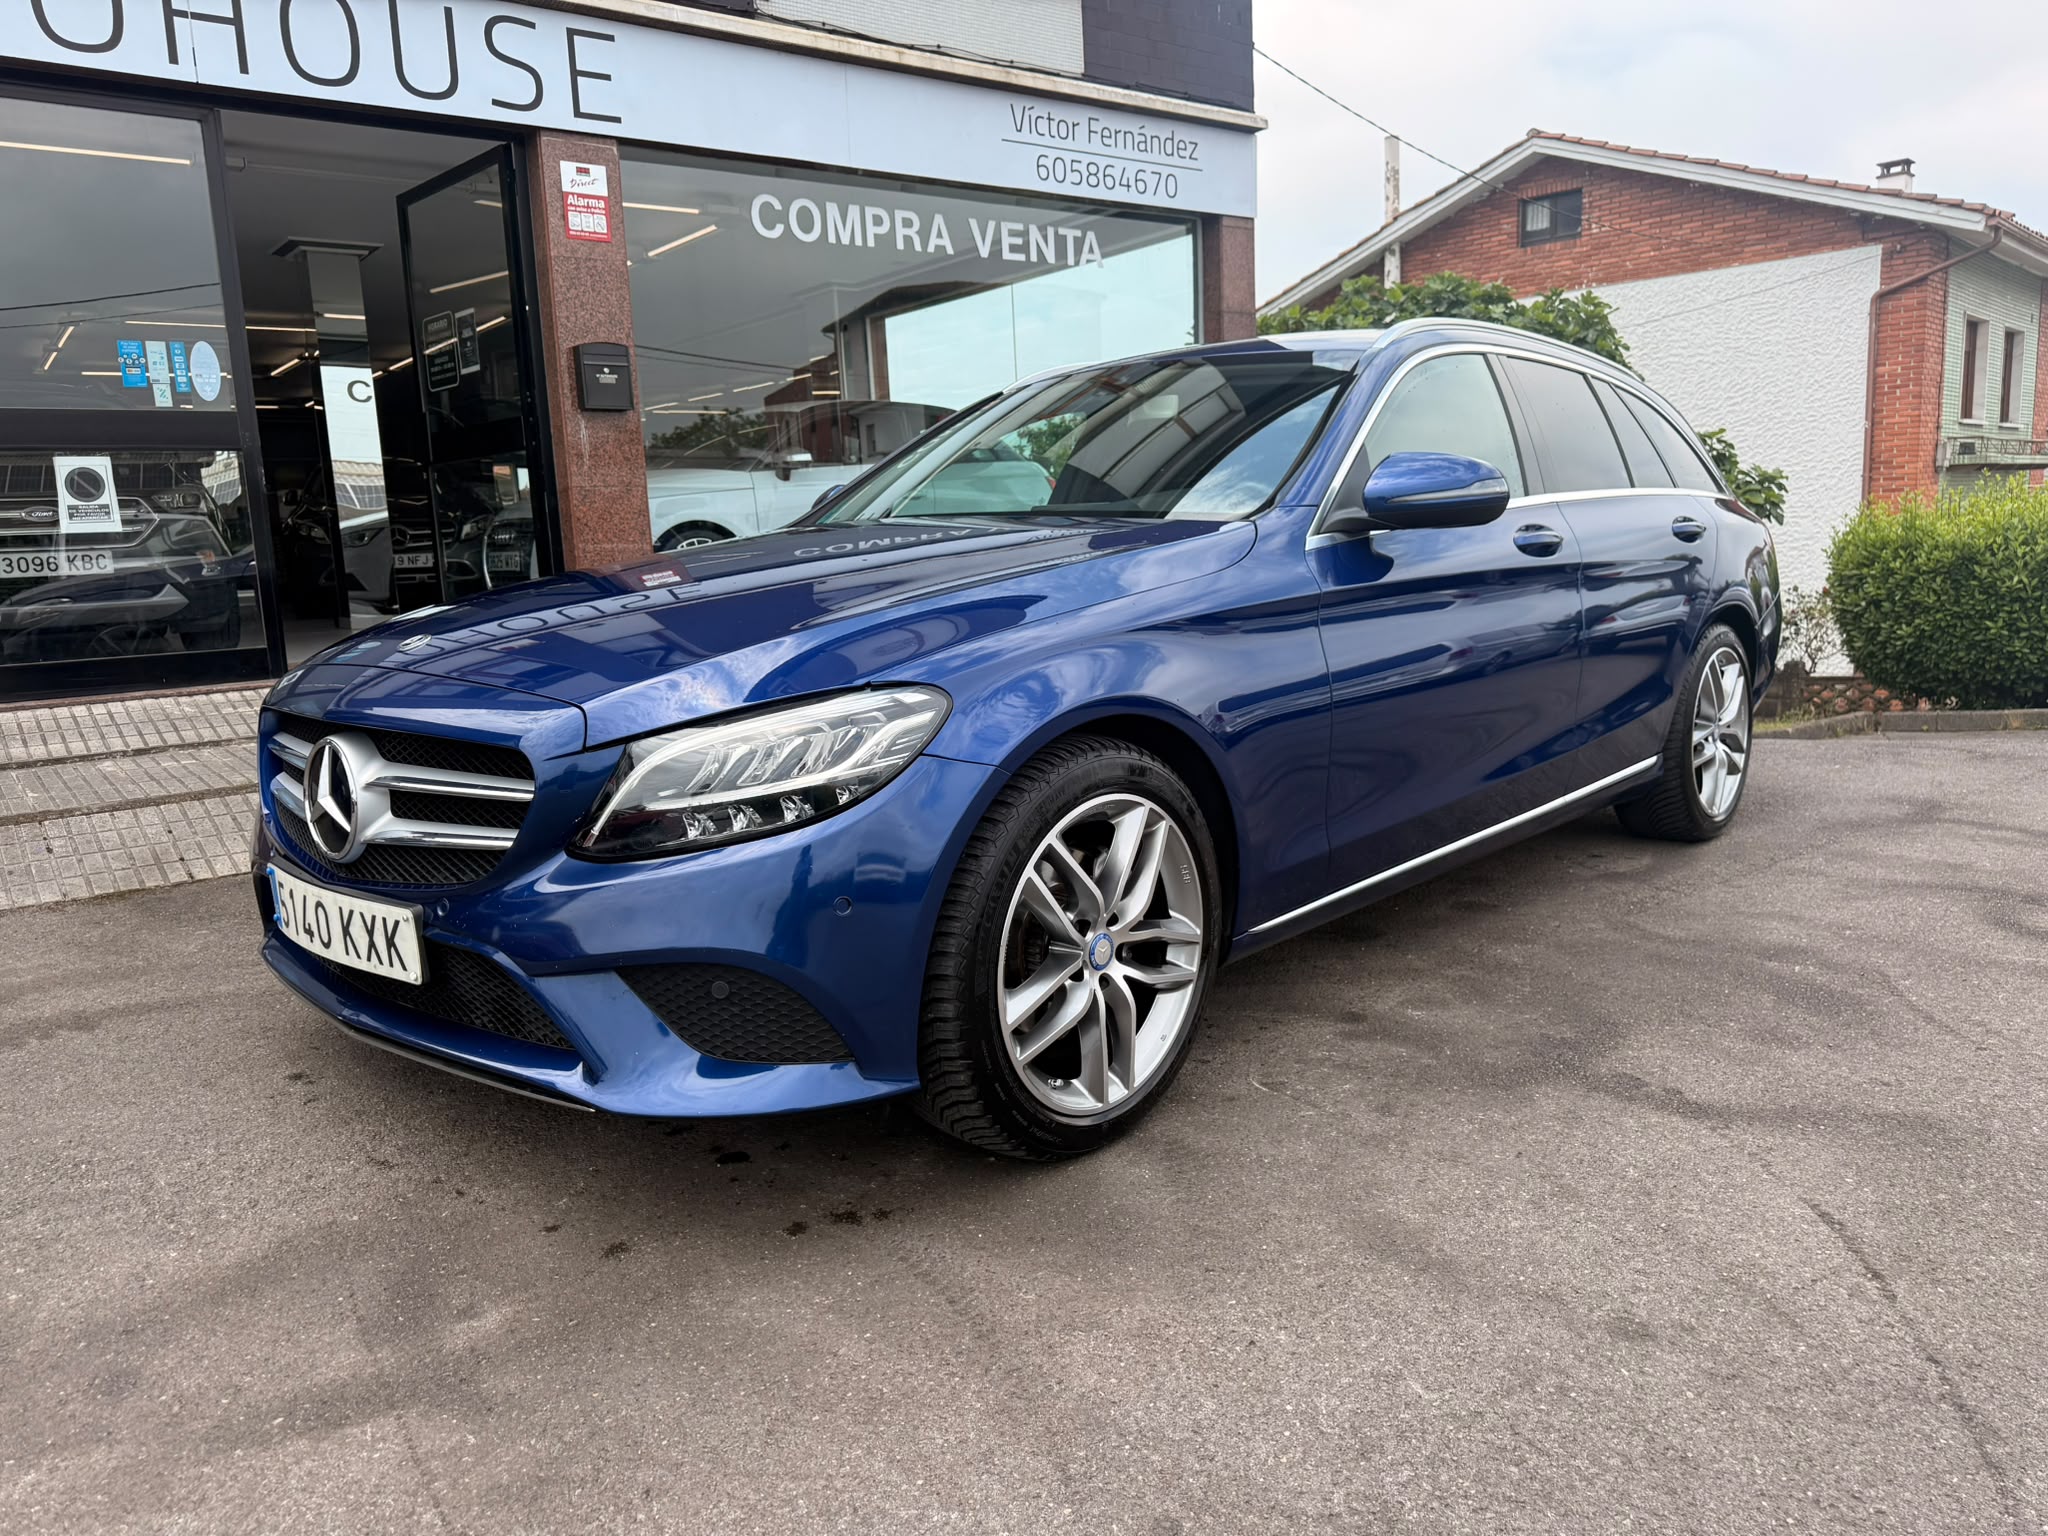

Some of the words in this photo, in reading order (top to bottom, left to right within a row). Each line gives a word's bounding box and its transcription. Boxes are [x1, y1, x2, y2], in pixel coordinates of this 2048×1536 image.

[1010, 103, 1080, 142] Víctor
[1087, 117, 1199, 161] Fernández
[1036, 154, 1178, 199] 605864670
[567, 194, 605, 208] Alarma
[750, 193, 954, 256] COMPRA
[968, 217, 1104, 269] VENTA
[2, 556, 59, 574] 3096
[66, 553, 108, 572] KBC
[407, 555, 429, 566] NFJ
[278, 882, 332, 950] 5140
[339, 906, 408, 971] KXK
